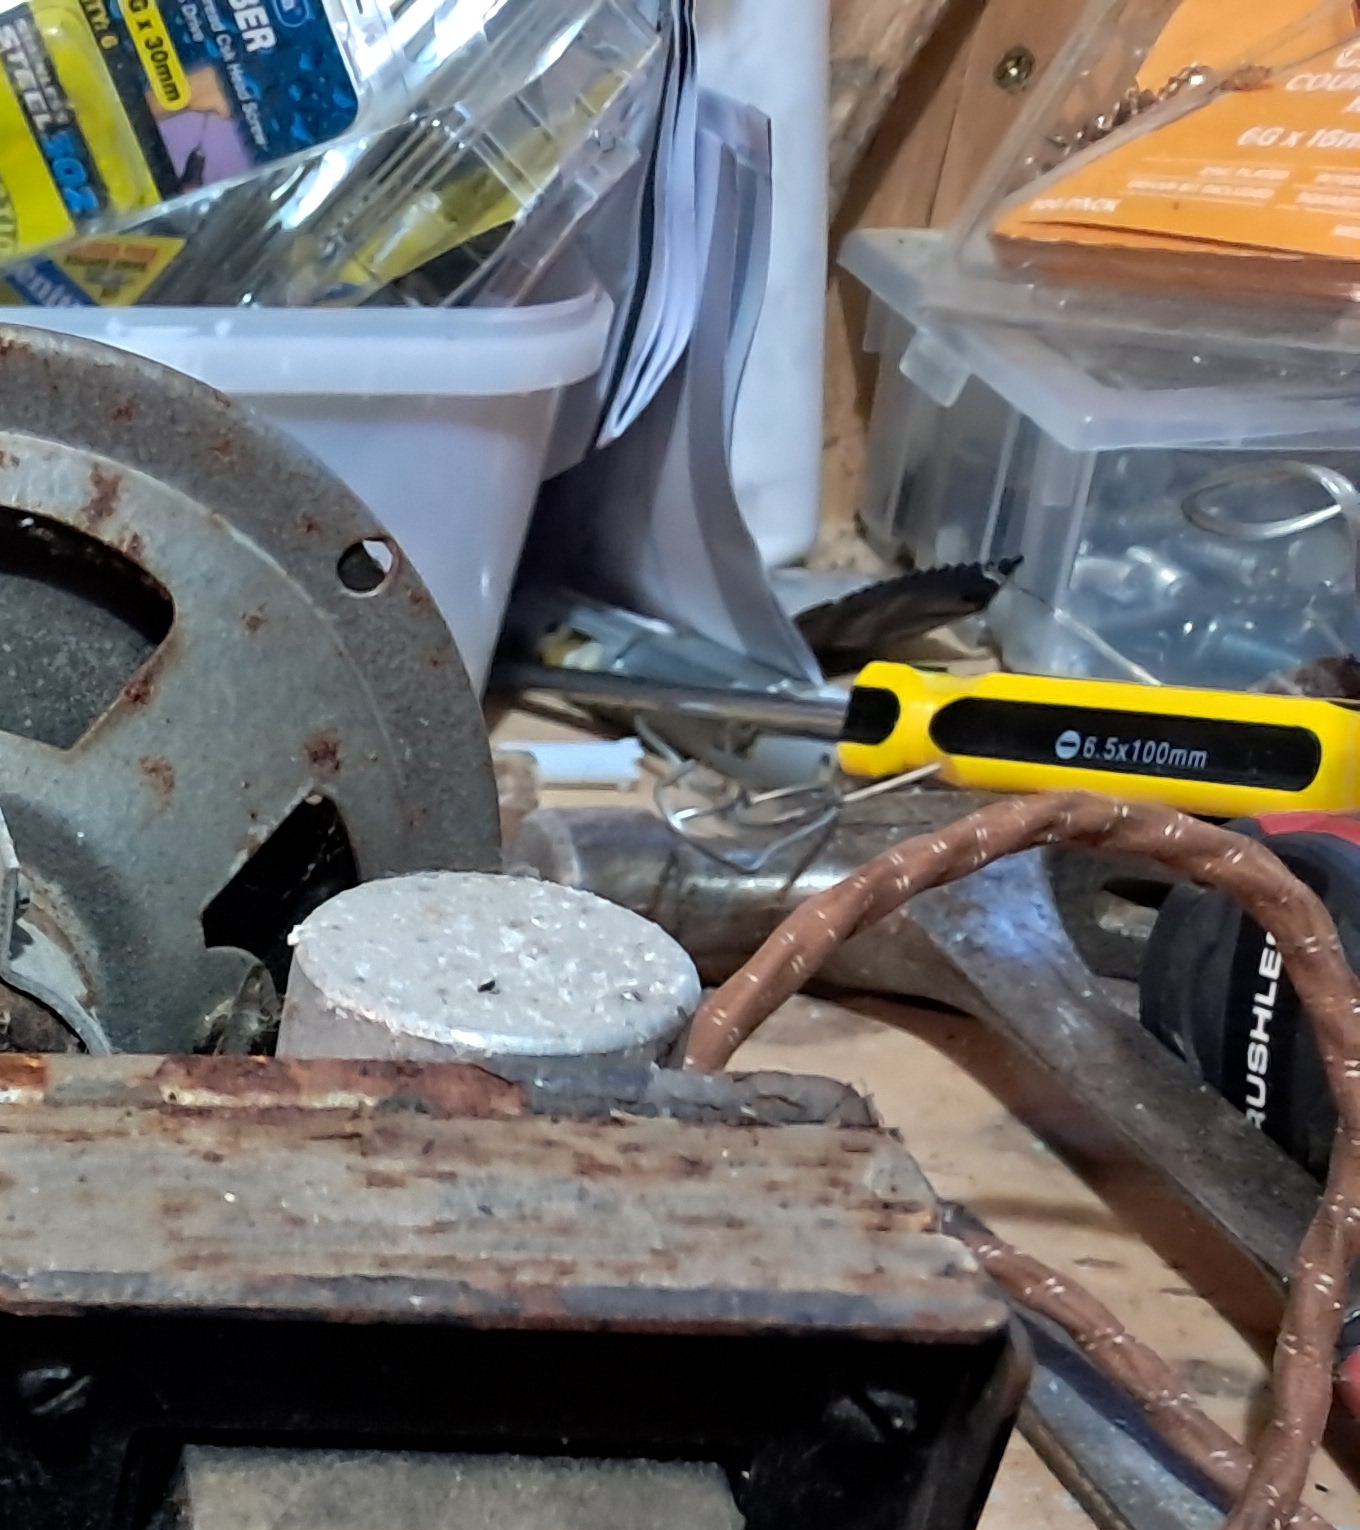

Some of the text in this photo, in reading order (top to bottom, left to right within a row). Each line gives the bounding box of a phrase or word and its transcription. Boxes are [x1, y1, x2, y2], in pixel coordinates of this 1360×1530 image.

[144, 36, 181, 102] 30mm
[1082, 735, 1208, 769] 6.5x100mm
[1245, 931, 1284, 1130] RUSHLE
